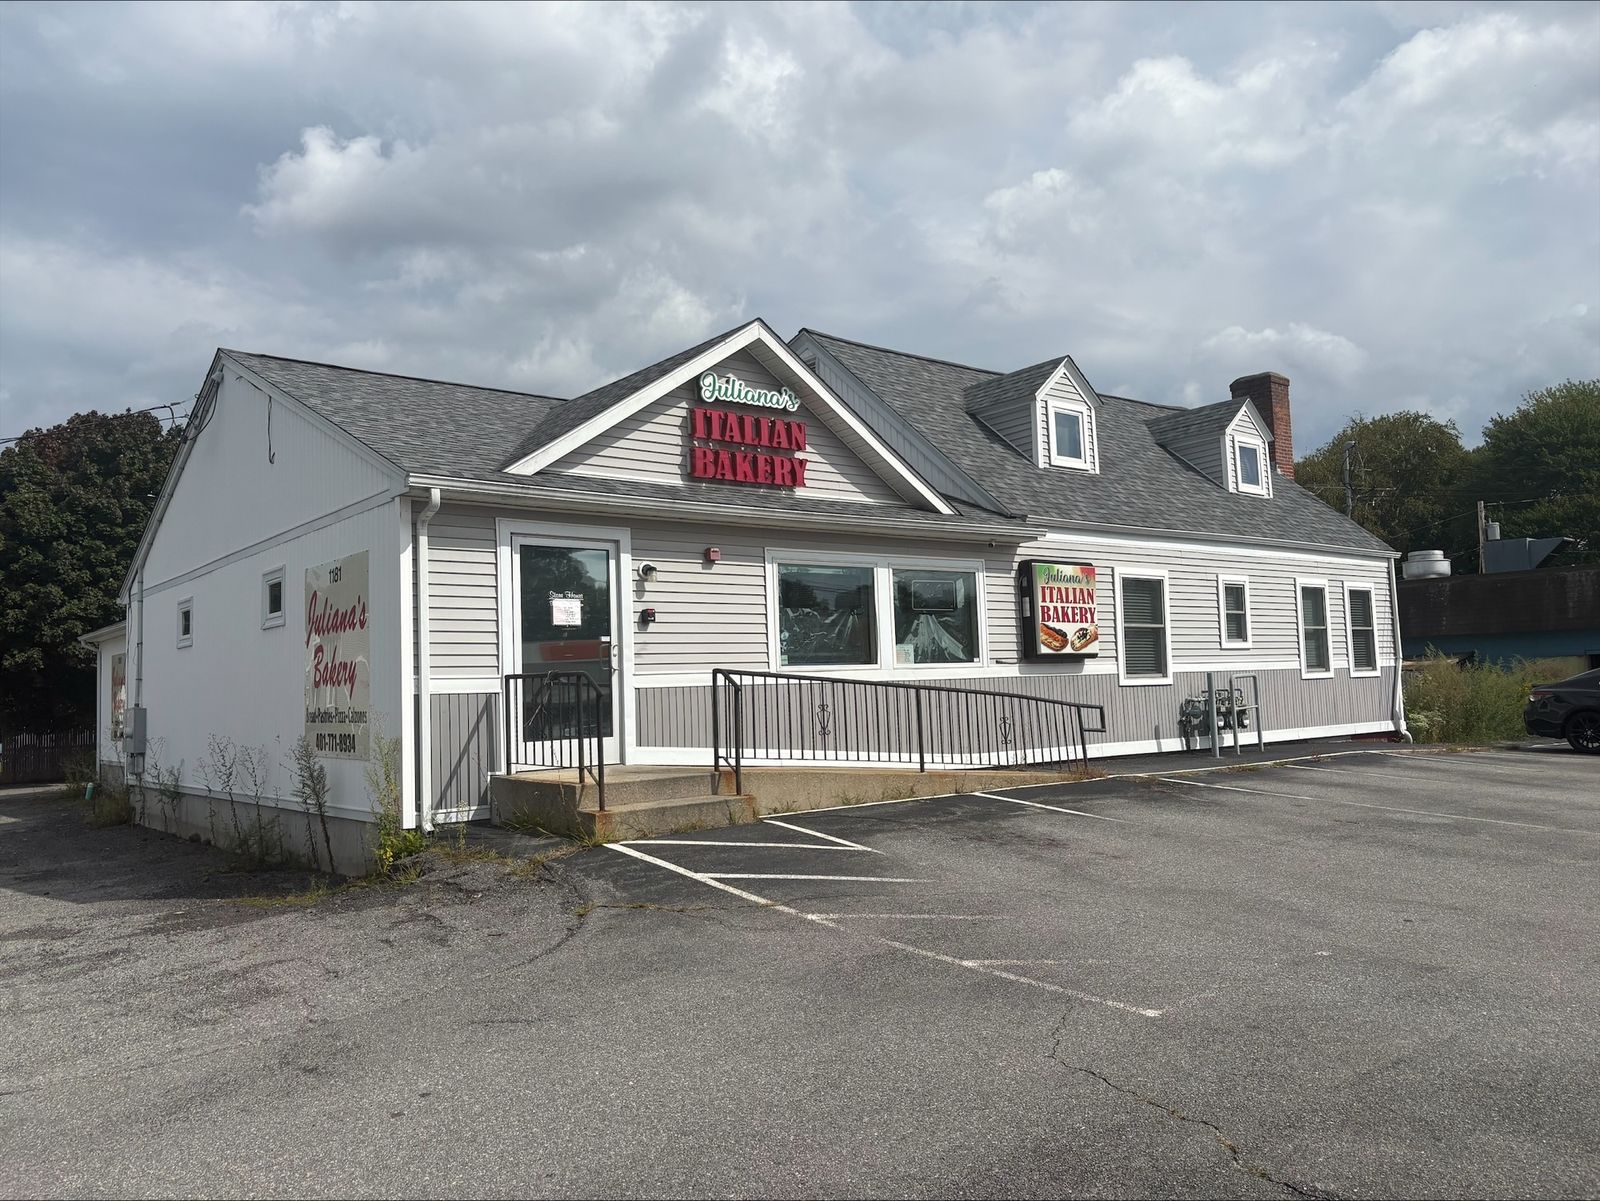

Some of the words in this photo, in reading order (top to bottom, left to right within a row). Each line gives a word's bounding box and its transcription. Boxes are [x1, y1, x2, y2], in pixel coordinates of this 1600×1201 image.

[700, 371, 800, 411] Juliana's
[693, 407, 807, 451] ITALIAN
[692, 447, 808, 488] BAKERY
[328, 566, 342, 584] 1181
[1044, 567, 1090, 585] Juliana's
[1040, 586, 1094, 605] ITALIAN
[1040, 605, 1096, 624] BAKERY
[305, 590, 368, 649] Juliana's
[313, 644, 357, 700] Bakery
